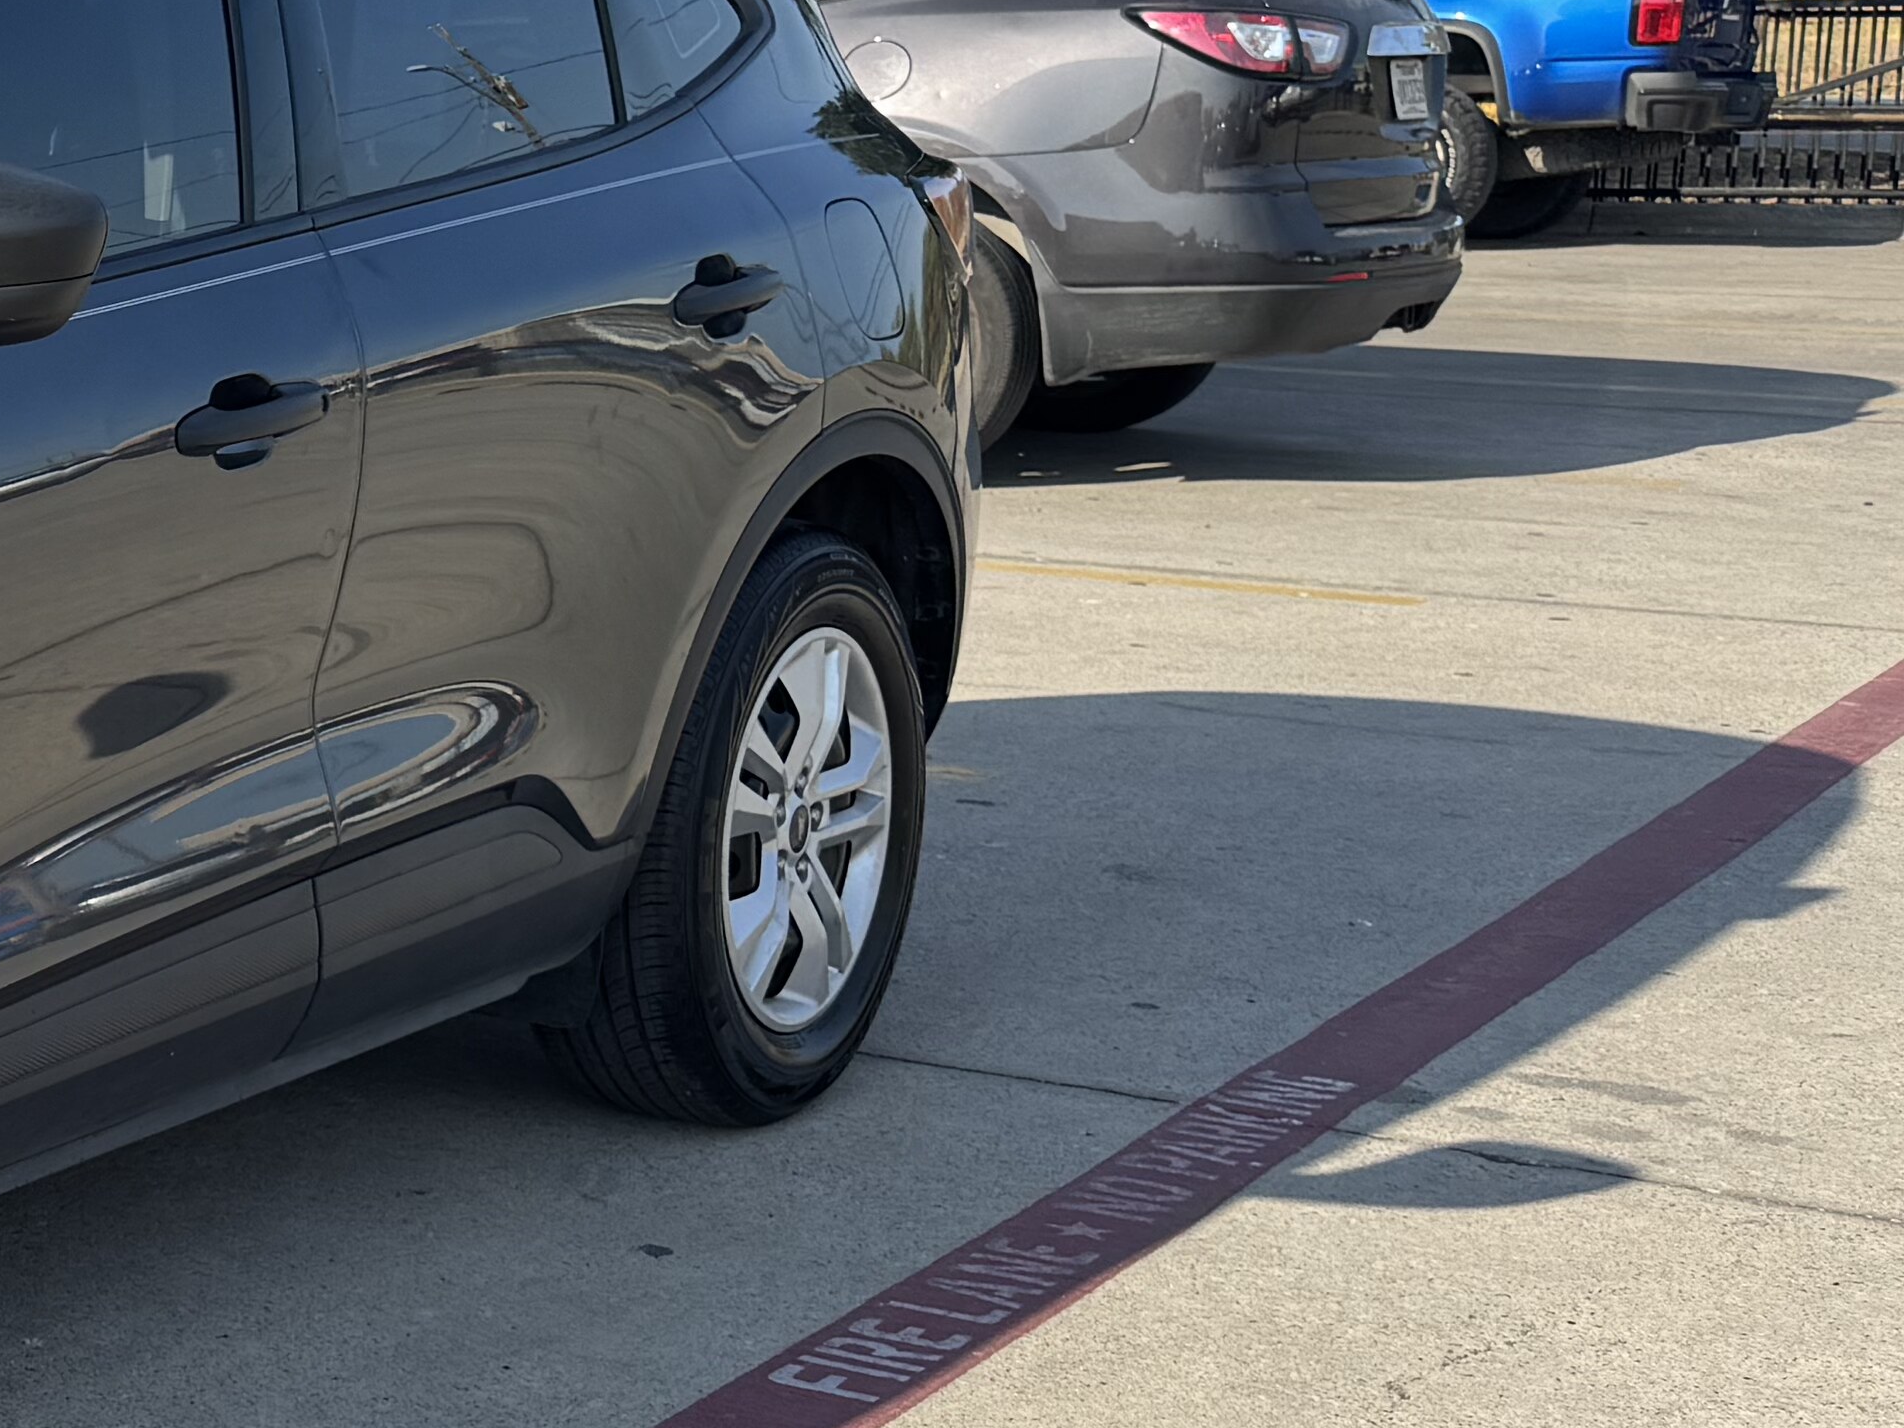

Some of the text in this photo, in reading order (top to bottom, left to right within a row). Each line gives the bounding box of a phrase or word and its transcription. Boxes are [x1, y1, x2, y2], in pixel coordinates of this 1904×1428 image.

[768, 1317, 972, 1403] FIRE
[888, 1237, 1100, 1325] LANE
[1053, 1175, 1193, 1223] NO
